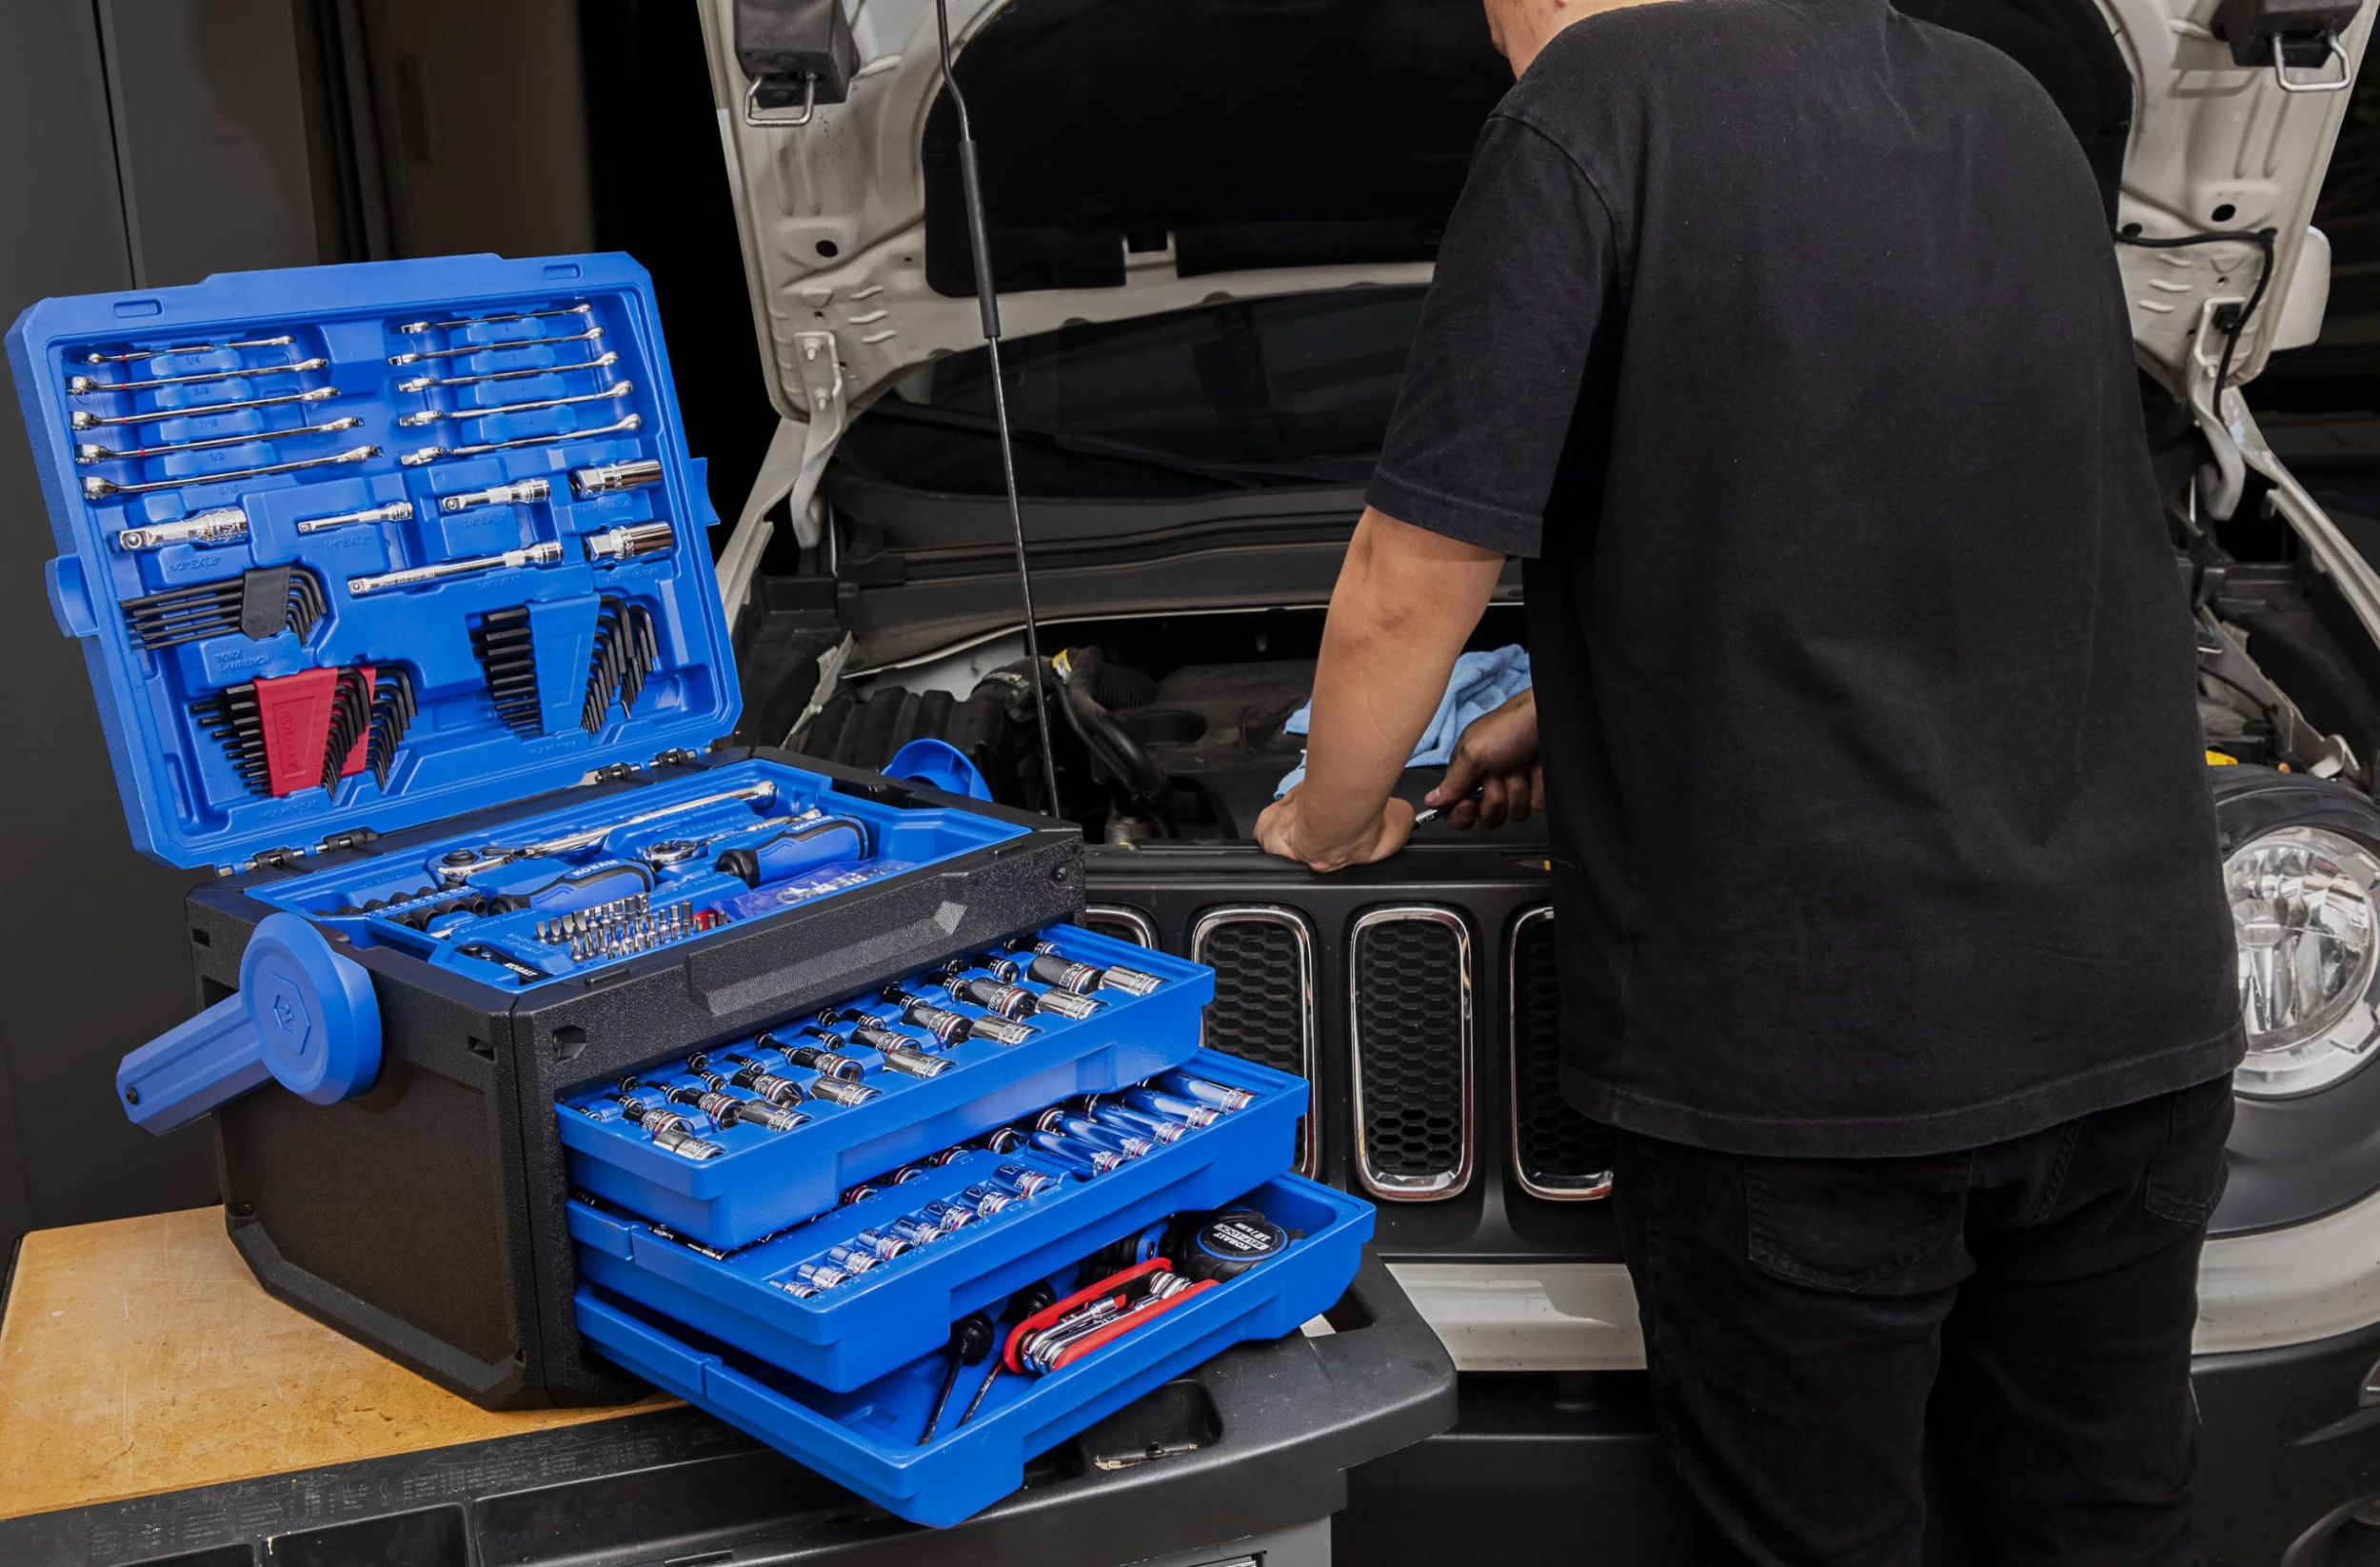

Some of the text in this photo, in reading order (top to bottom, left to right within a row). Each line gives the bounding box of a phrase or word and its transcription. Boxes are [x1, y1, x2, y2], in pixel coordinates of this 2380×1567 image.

[503, 962, 539, 977] KOBALT
[1213, 1232, 1253, 1252] KOBALT
[1219, 1224, 1264, 1249] SELF-LOCK
